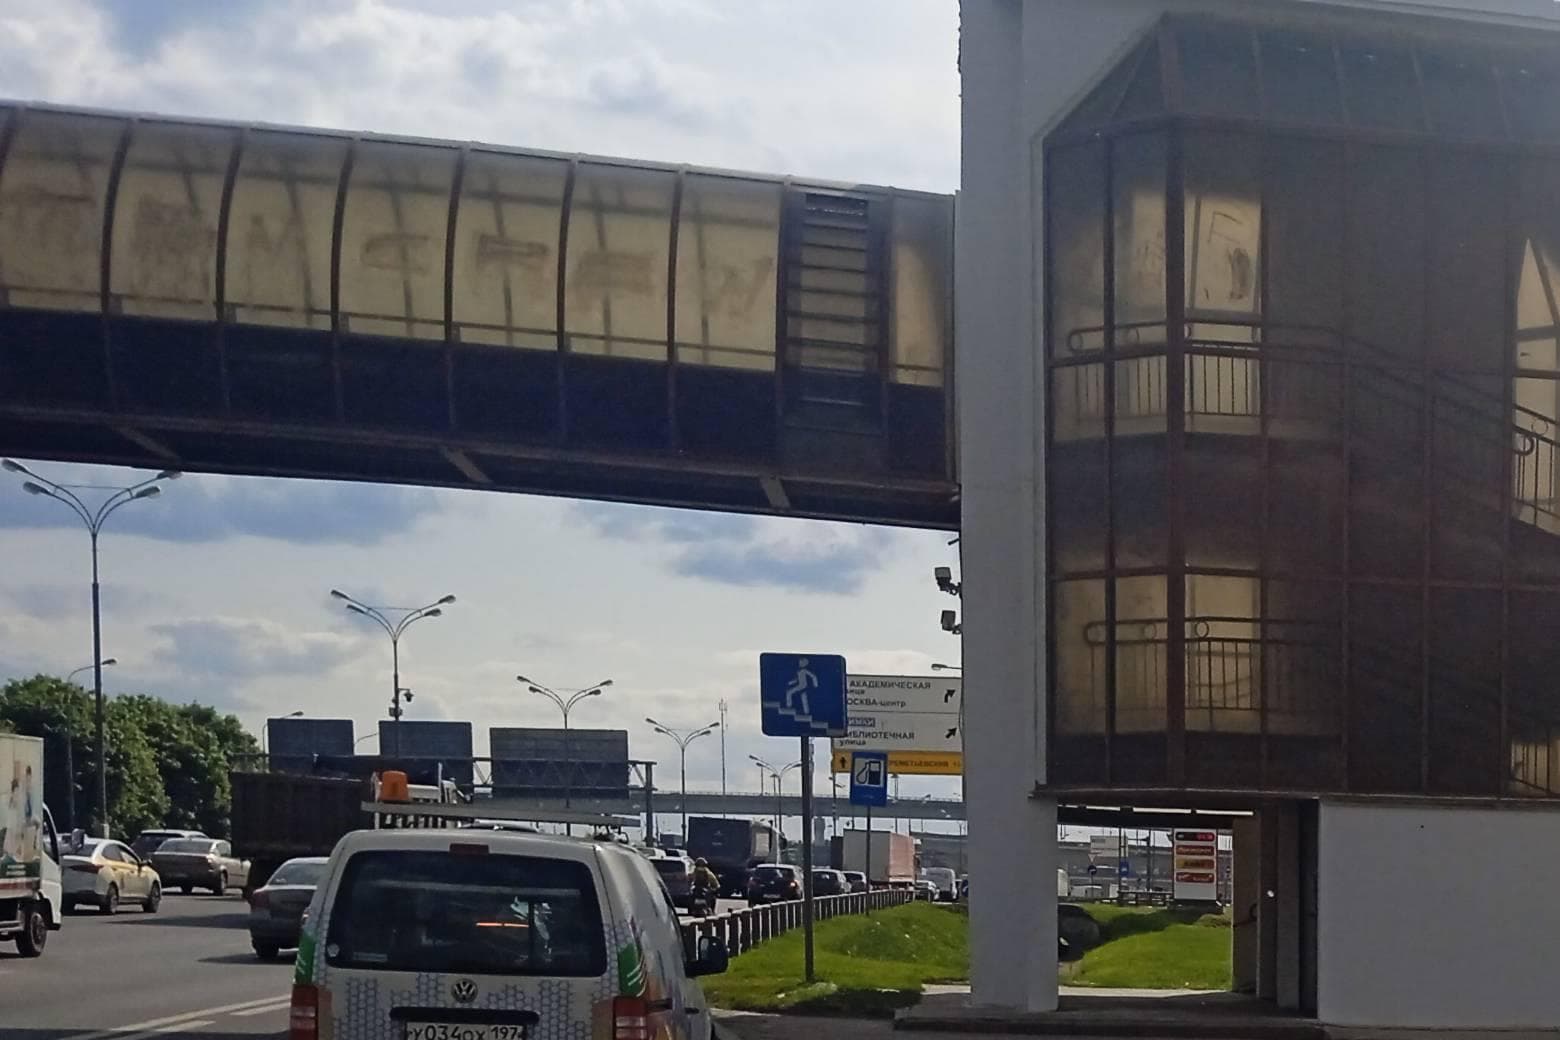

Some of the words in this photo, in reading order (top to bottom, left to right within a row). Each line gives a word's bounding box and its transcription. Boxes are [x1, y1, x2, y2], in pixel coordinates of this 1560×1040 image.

[849, 680, 932, 690] АКАДЕМИЧЕСКАЯ
[846, 697, 907, 708] ОСКВА-центр
[846, 731, 915, 740] ИБЛИОТЕЧНАЯ
